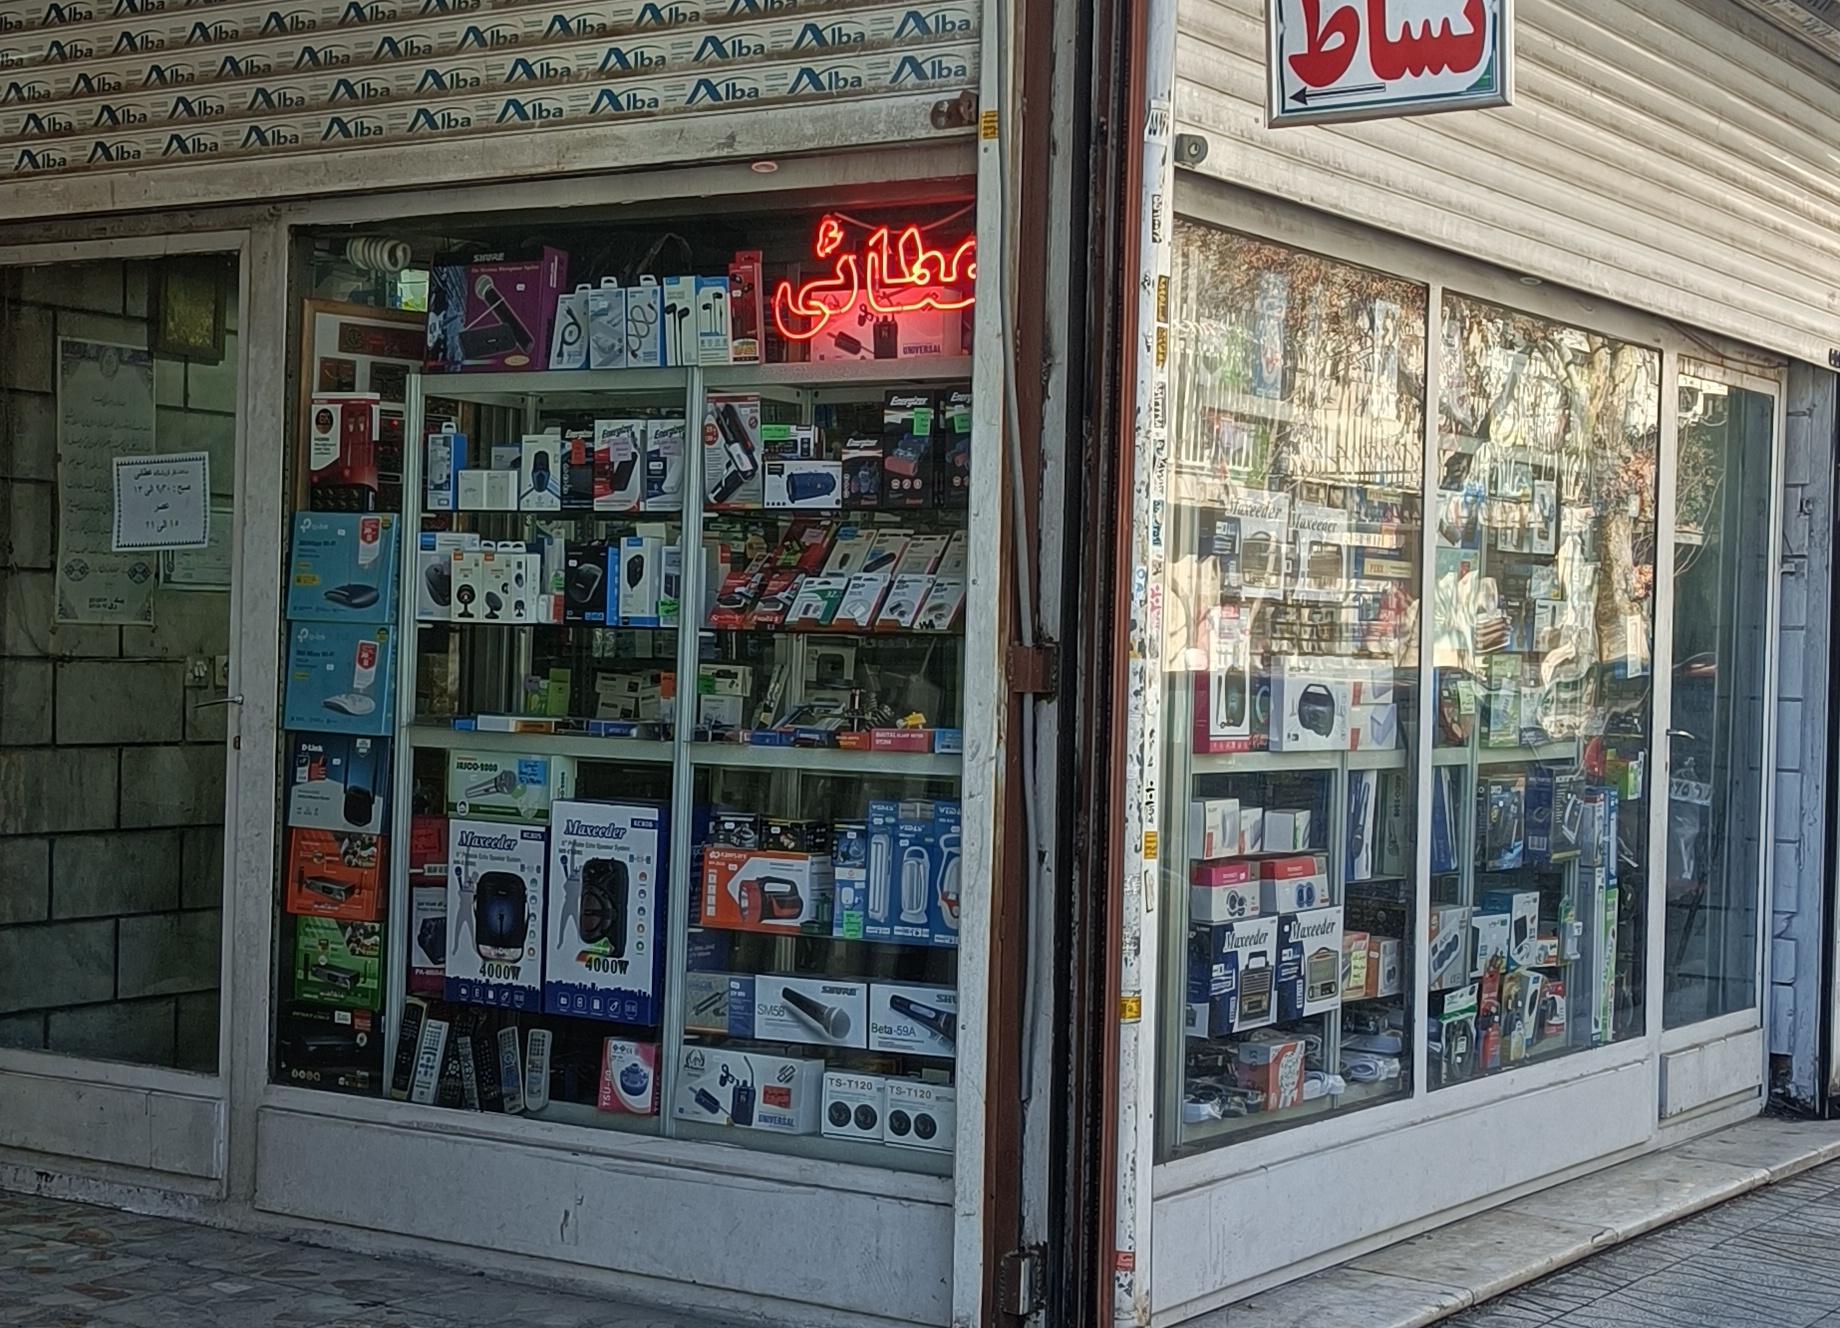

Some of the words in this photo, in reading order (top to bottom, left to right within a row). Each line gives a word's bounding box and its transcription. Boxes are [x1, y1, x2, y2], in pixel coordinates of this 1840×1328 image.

[0, 12, 22, 30] lba
[41, 3, 93, 26] Alba
[44, 39, 93, 63] Alba
[112, 30, 164, 54] Alba
[185, 21, 239, 45] Alba
[259, 11, 316, 36] Alba
[339, 0, 398, 26] Alba
[3, 81, 50, 104] Alba
[70, 73, 121, 96] Alba
[143, 64, 195, 87] Alba
[215, 55, 271, 79] Alba
[293, 45, 350, 70] Alba
[372, 35, 432, 62] Alba
[456, 24, 519, 51] Alba
[542, 13, 607, 41] Alba
[634, 1, 700, 26] Alba
[20, 112, 72, 136] Alba
[94, 103, 147, 127] Alba
[168, 95, 224, 120] Alba
[247, 86, 305, 111] Alba
[328, 77, 390, 104] Alba
[415, 68, 480, 95] Alba
[504, 57, 571, 83] Alba
[599, 45, 667, 74] Alba
[692, 34, 765, 62] Alba
[793, 22, 866, 51] Alba
[894, 9, 971, 39] Alba
[13, 149, 67, 171] Alba
[87, 140, 141, 164] Alba
[162, 132, 219, 157] Alba
[240, 124, 299, 149] Alba
[321, 116, 383, 142] Alba
[407, 107, 472, 133] Alba
[496, 97, 564, 124] Alba
[588, 88, 659, 115] Alba
[685, 78, 760, 106] Alba
[788, 67, 862, 95] Alba
[890, 55, 967, 85] Alba
[565, 820, 627, 839] Maxeeder
[458, 830, 518, 851] Maxeeder
[1225, 930, 1268, 950] Maxeeder
[1290, 918, 1336, 942] Maxeeder
[480, 962, 521, 980] 4000W
[585, 958, 629, 975] 4000W
[936, 993, 957, 1004] SHU
[757, 1003, 785, 1017] SM58
[828, 1077, 873, 1090] TS-T120
[889, 1085, 932, 1099] TS-T120
